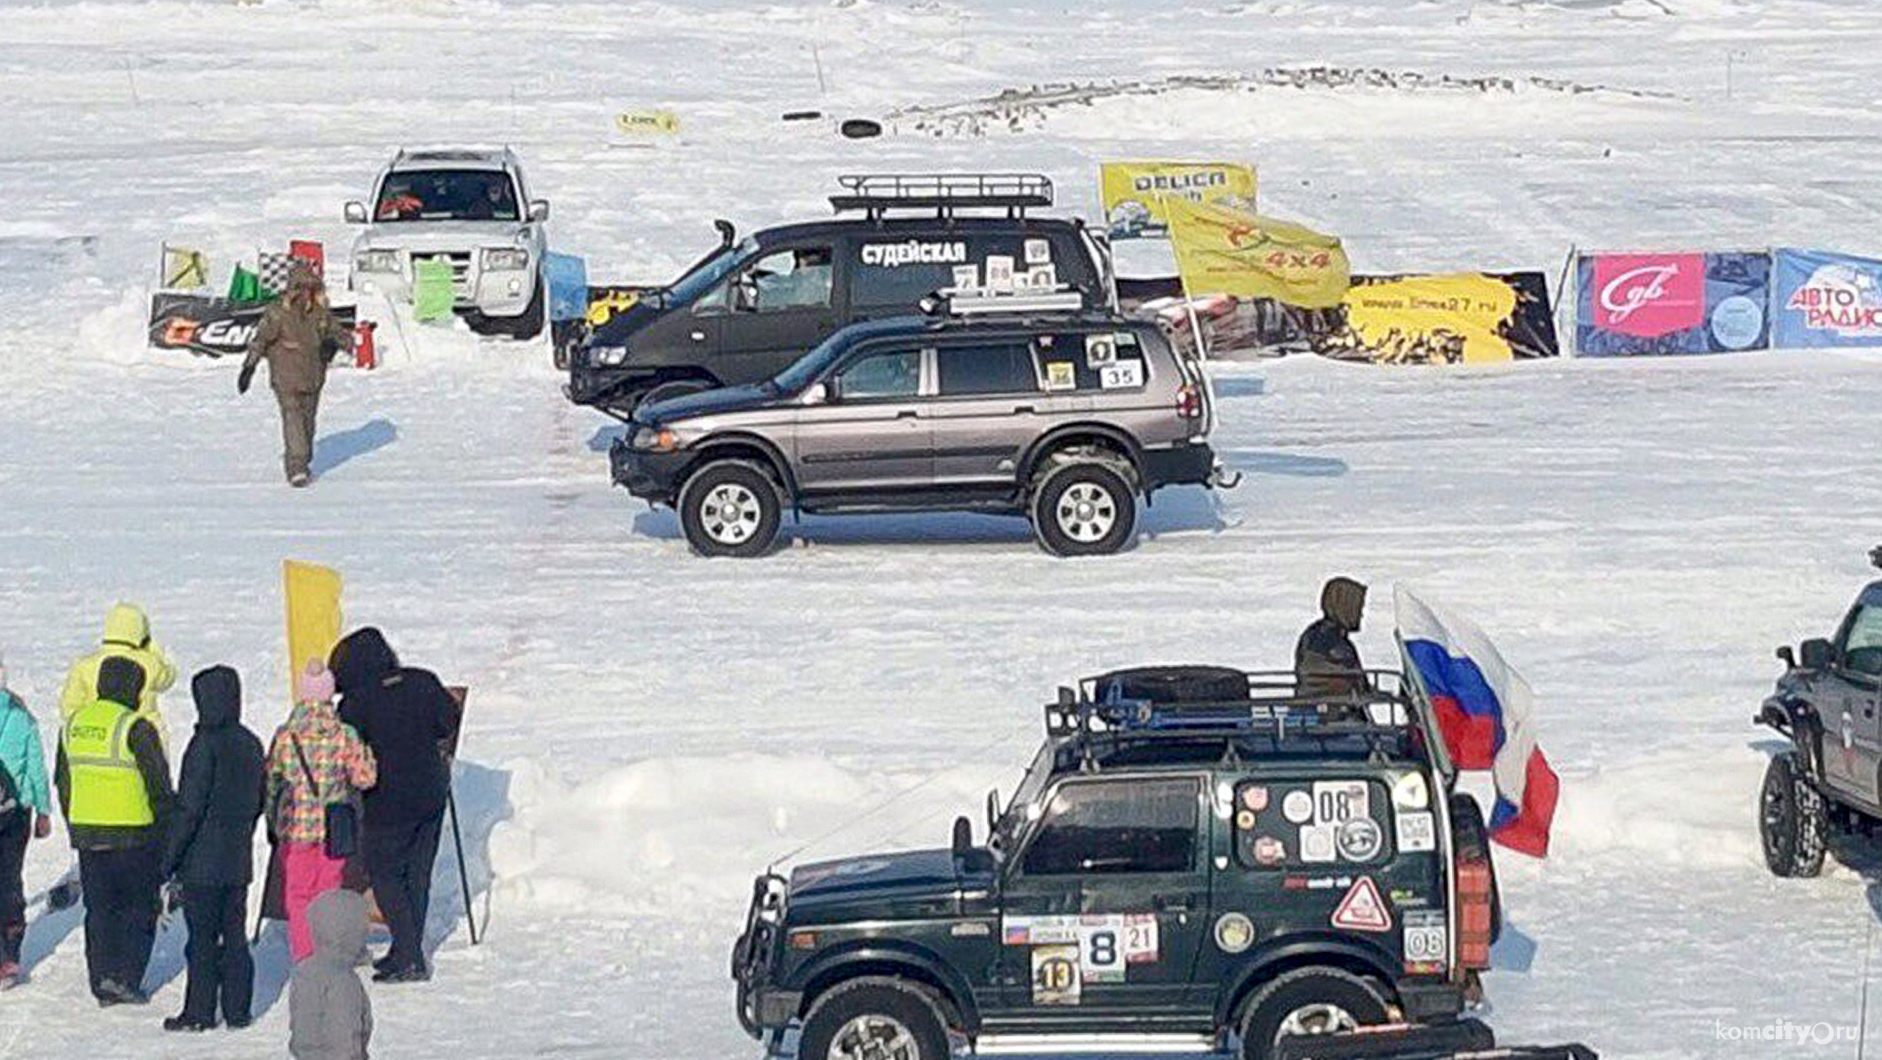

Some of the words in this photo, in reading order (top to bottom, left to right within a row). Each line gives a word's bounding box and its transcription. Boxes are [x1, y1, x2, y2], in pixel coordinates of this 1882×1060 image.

[861, 239, 967, 267] СУДЕЙСКАЯ
[1792, 287, 1856, 308] АВТО
[1107, 369, 1134, 385] 35
[1319, 790, 1351, 823] 08
[1089, 930, 1117, 966] 8
[1128, 928, 1151, 949] 21
